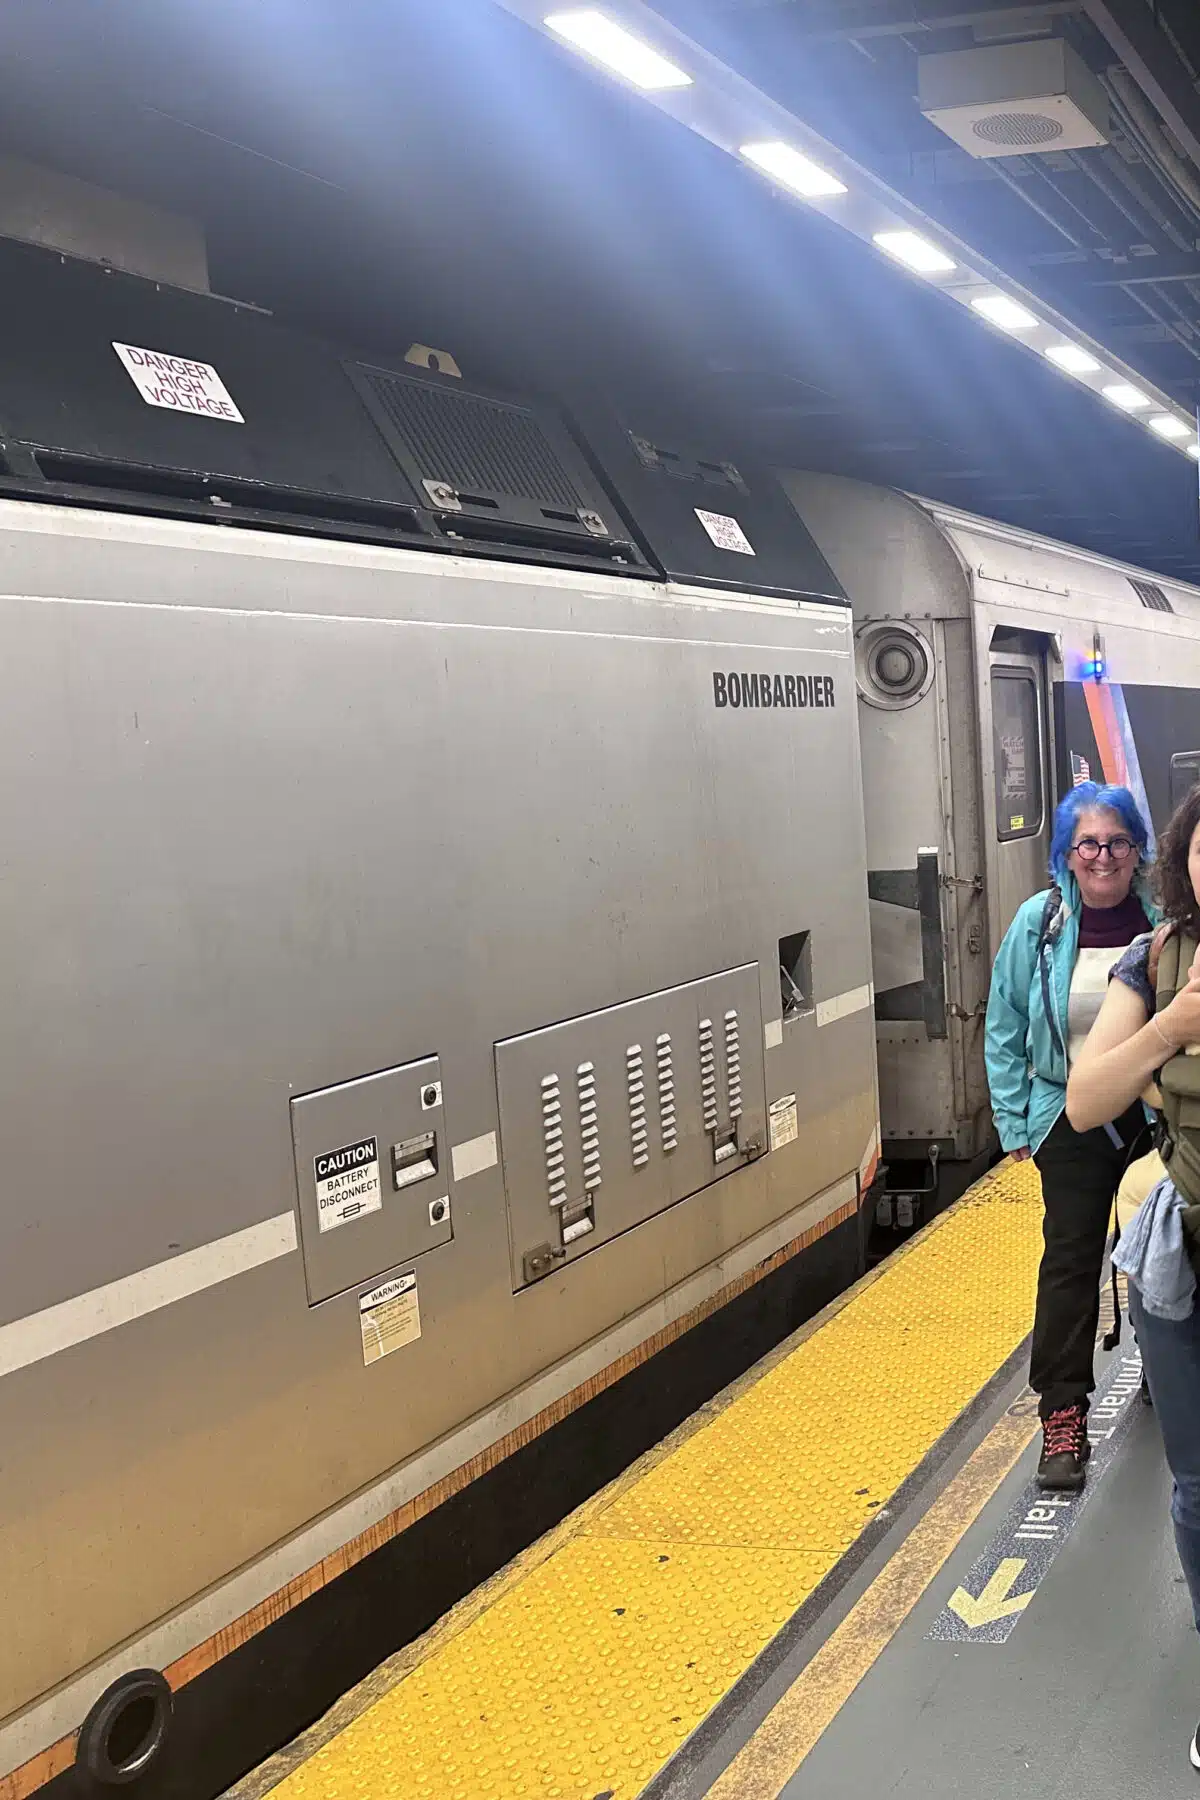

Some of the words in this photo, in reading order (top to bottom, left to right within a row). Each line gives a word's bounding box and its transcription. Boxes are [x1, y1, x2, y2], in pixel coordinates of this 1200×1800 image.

[126, 348, 213, 382] DANGER
[154, 370, 207, 396] HIGH
[144, 385, 236, 418] VOLTAGE
[713, 671, 836, 708] BOMBARDIER
[317, 1142, 375, 1176] CAUTION
[320, 1179, 379, 1210] DISCONNECT
[327, 1167, 370, 1192] BATTERY
[371, 1279, 406, 1302] WARNING
[1091, 1348, 1143, 1420] ynihan
